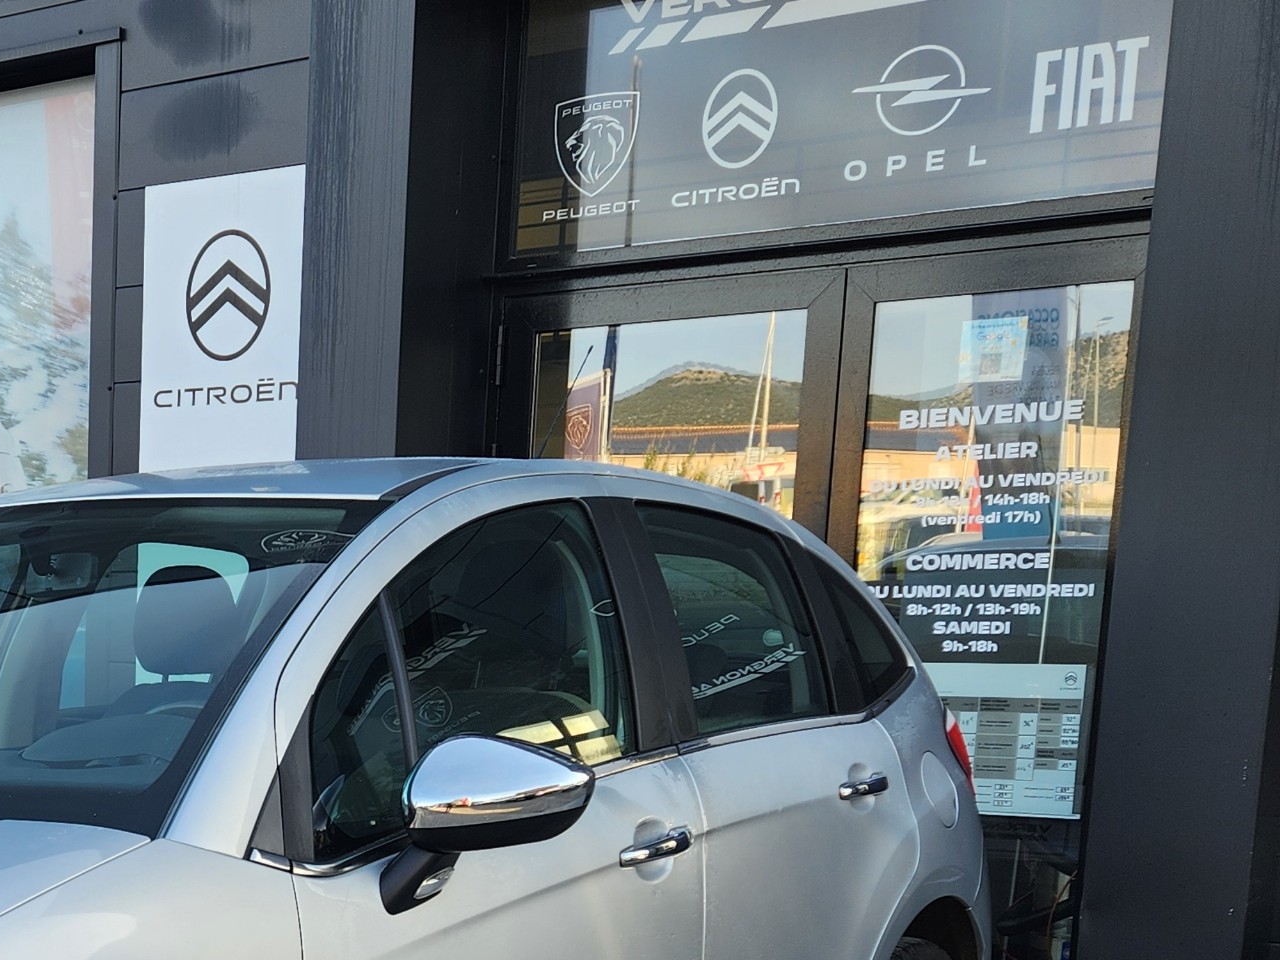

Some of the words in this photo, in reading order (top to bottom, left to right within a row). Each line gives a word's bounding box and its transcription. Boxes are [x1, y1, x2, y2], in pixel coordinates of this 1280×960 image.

[1029, 36, 1150, 134] FIAT
[561, 99, 633, 118] PEUGEOT
[843, 145, 987, 182] OPEL
[542, 199, 640, 222] PEUGEOT
[899, 400, 1085, 430] BIENVENUE
[935, 441, 1039, 462] ATELIER
[963, 474, 994, 490] AU
[997, 470, 1107, 488] VENDREDI
[985, 492, 1050, 506] 14h-18h
[921, 512, 1001, 528] (vendredi
[1005, 510, 1041, 526] 17h)
[906, 552, 1051, 571] COMMERCE
[892, 584, 952, 599] LUNDI
[955, 584, 985, 598] AU
[989, 583, 1095, 598] VENDREDI
[906, 604, 962, 616] 8h-12h
[976, 602, 1041, 616] 13h-19h
[932, 621, 1011, 635] SAMEDI
[942, 640, 998, 653] 9h-18h
